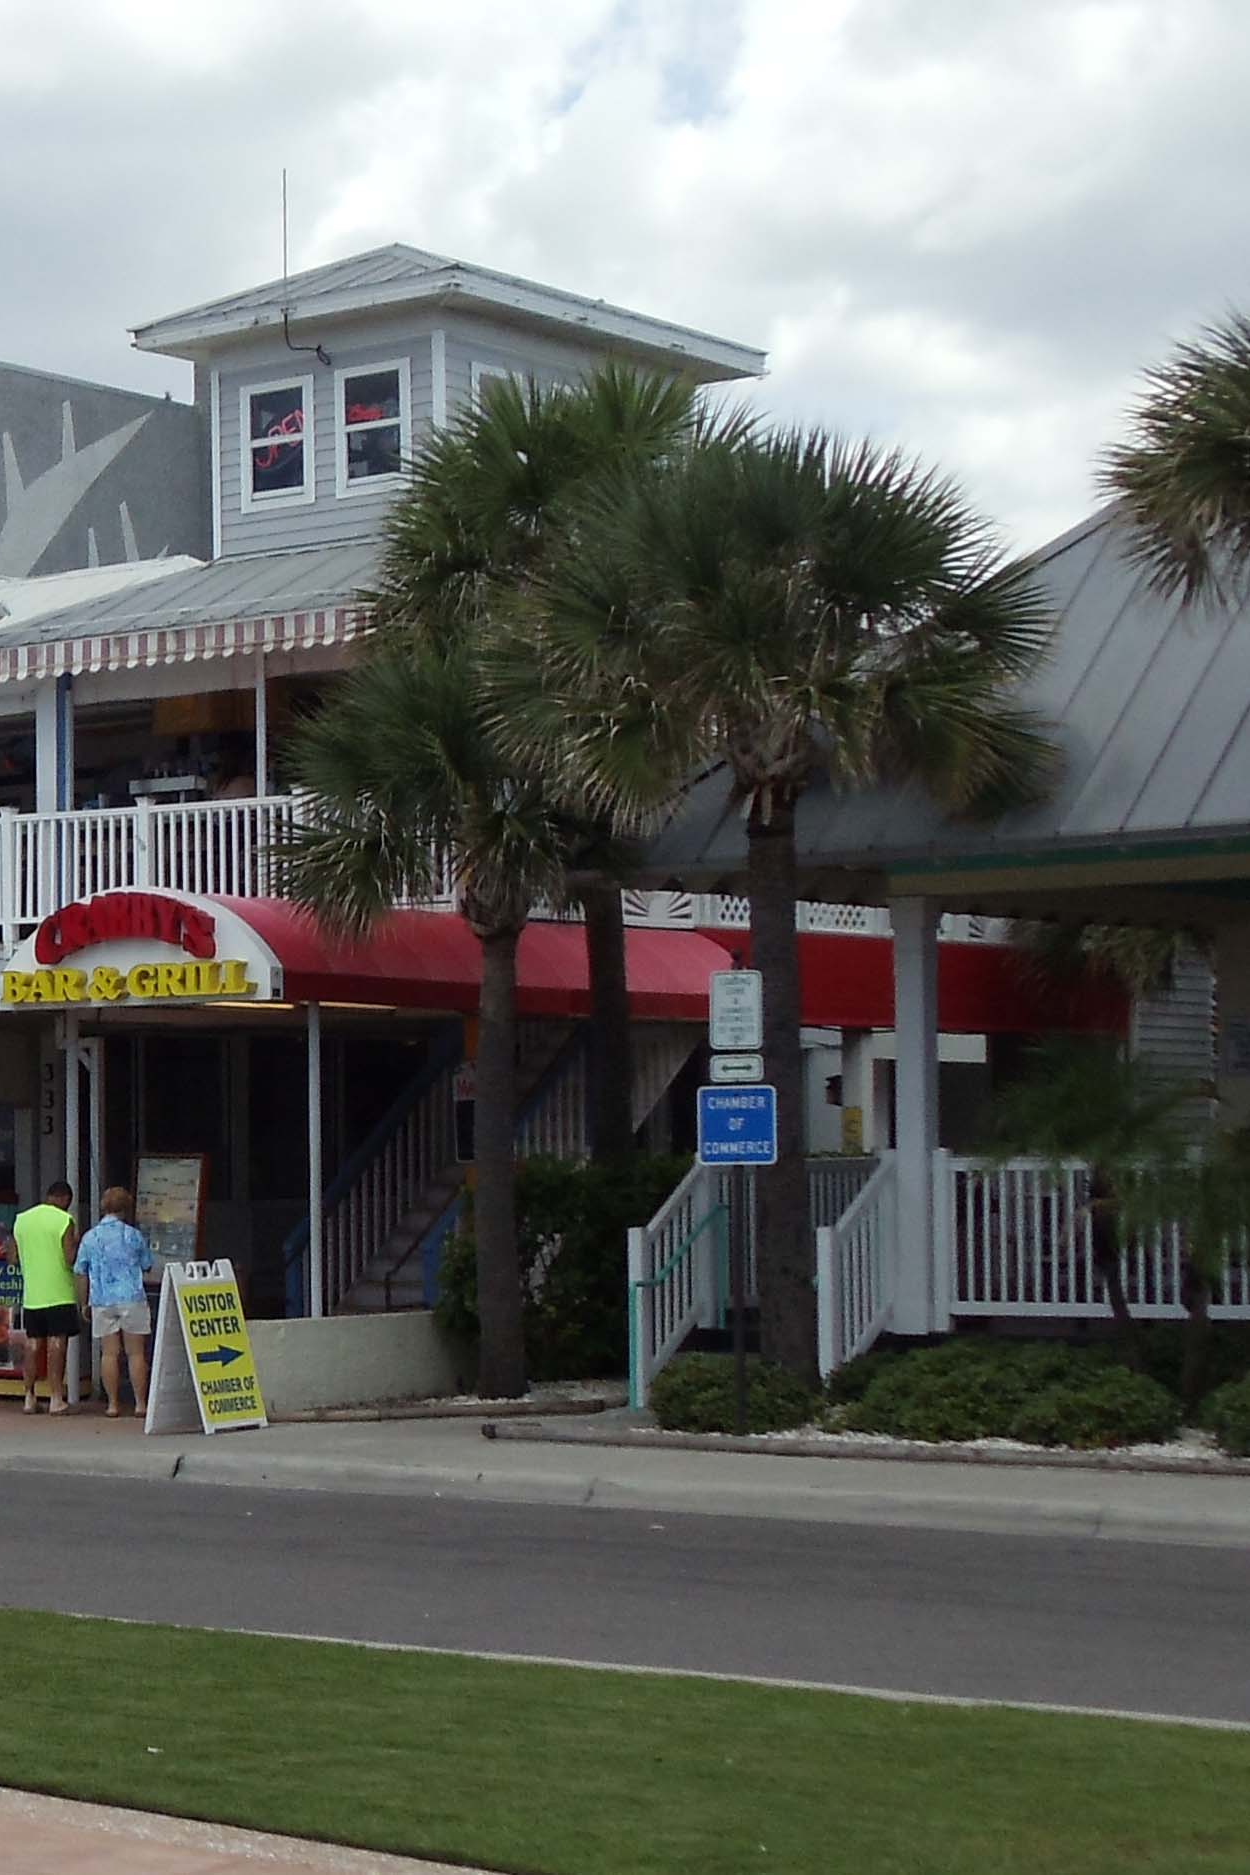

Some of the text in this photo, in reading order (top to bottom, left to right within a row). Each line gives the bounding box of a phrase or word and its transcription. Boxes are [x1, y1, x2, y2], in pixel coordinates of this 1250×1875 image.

[1, 960, 258, 1004] BAR & GRILL
[707, 1096, 766, 1109] CHAMBER
[728, 1115, 745, 1131] OF
[703, 1140, 771, 1155] COMMERCE
[6, 1264, 22, 1276] Ou
[184, 1292, 236, 1314] VISITOR
[189, 1316, 241, 1337] CENTER
[200, 1376, 255, 1395] CHAMBER OF
[208, 1396, 257, 1415] COMMERCE
